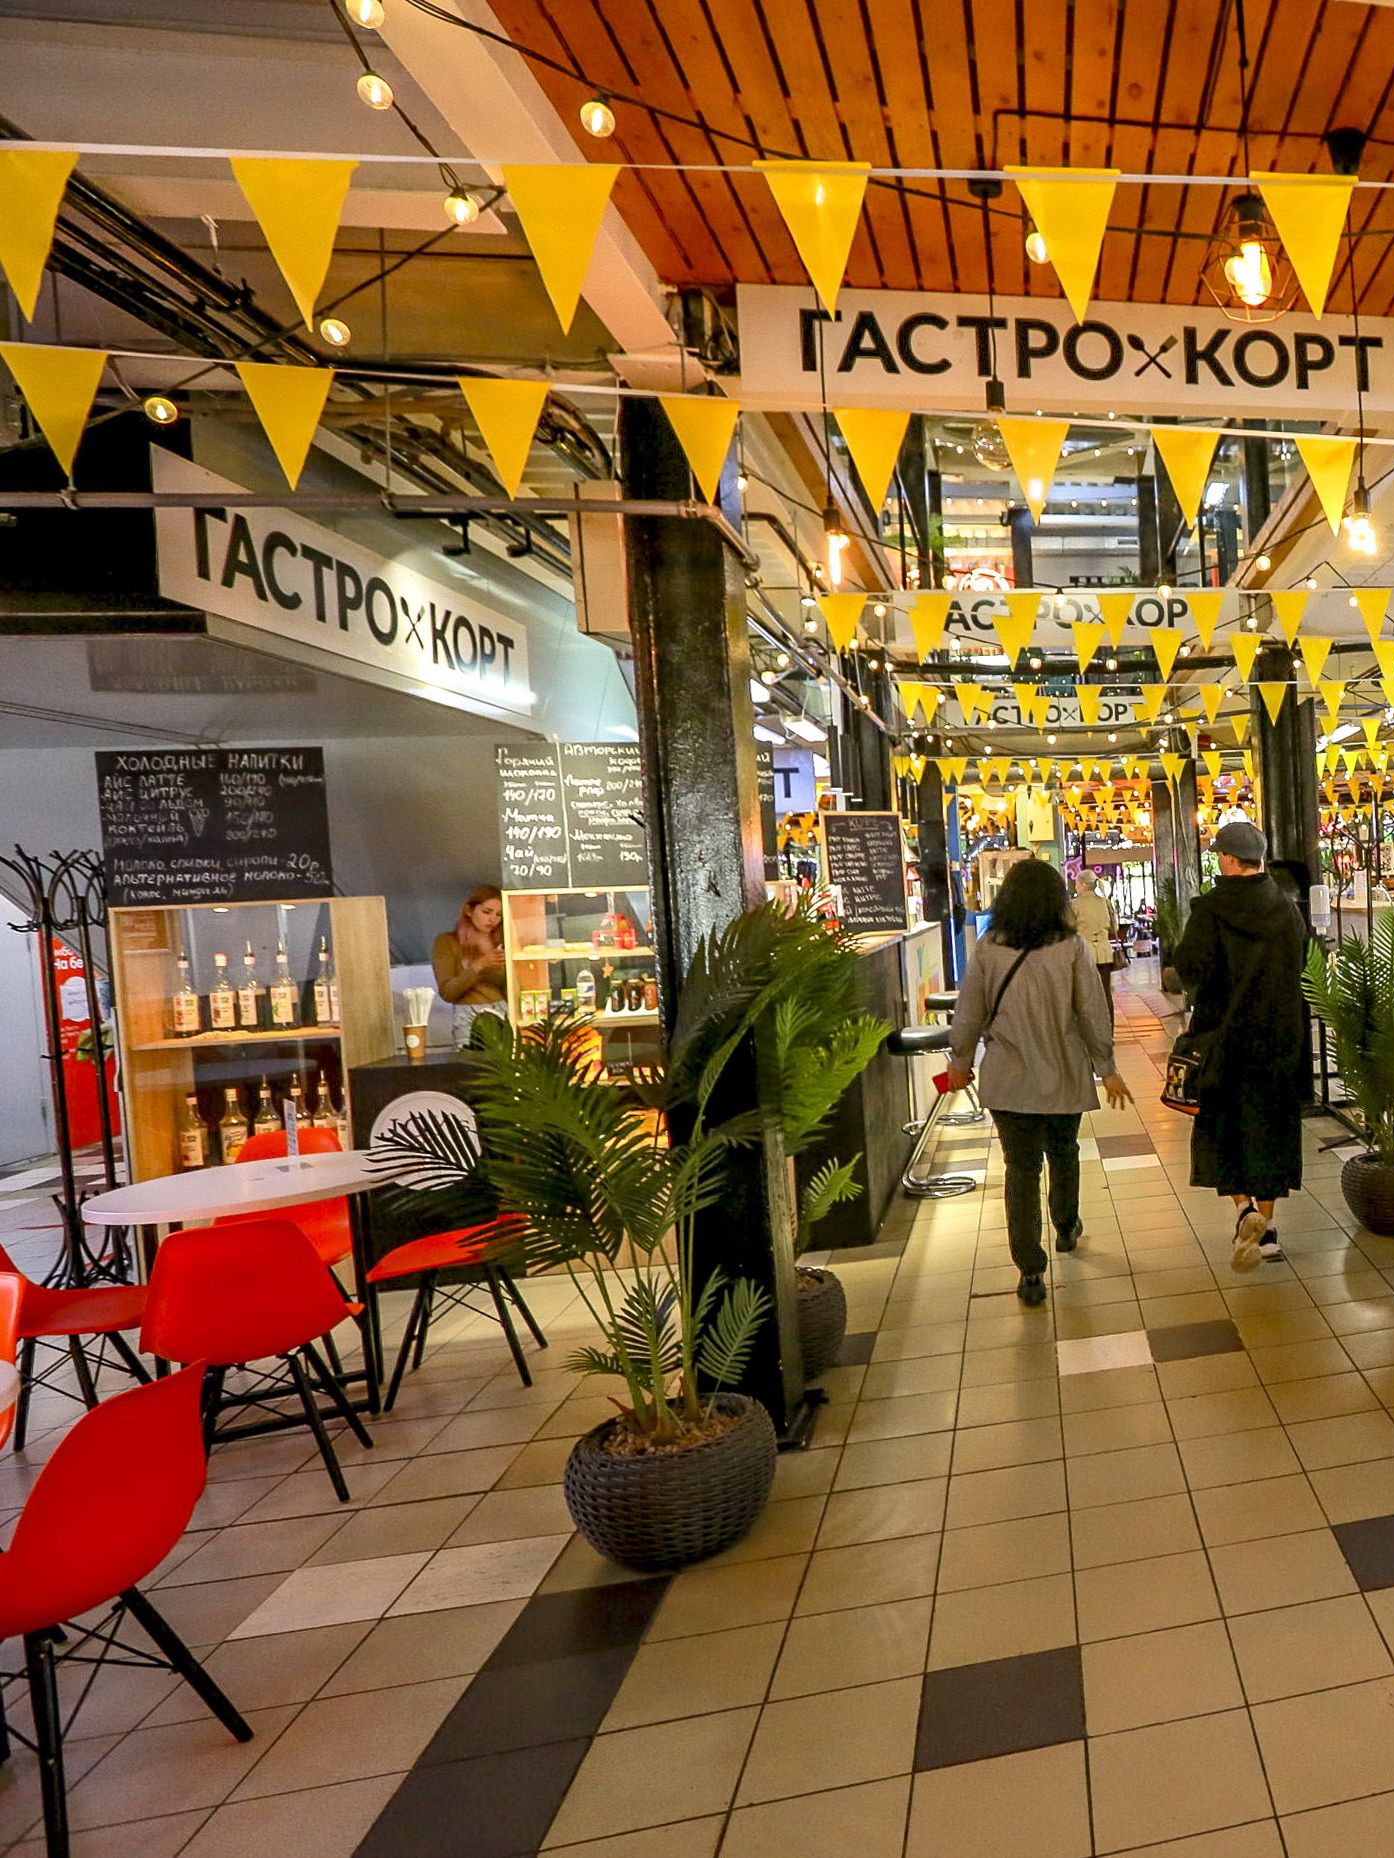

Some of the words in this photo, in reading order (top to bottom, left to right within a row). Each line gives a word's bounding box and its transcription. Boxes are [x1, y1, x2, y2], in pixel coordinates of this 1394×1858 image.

[799, 307, 1125, 381] ГАСТРО
[1183, 327, 1383, 392] КОРТ
[193, 507, 398, 644] ГАСТРО
[429, 602, 514, 686] КОРТ
[116, 754, 216, 771] ХОЛОДНЫЕ
[228, 753, 303, 770] НАПИТКИ
